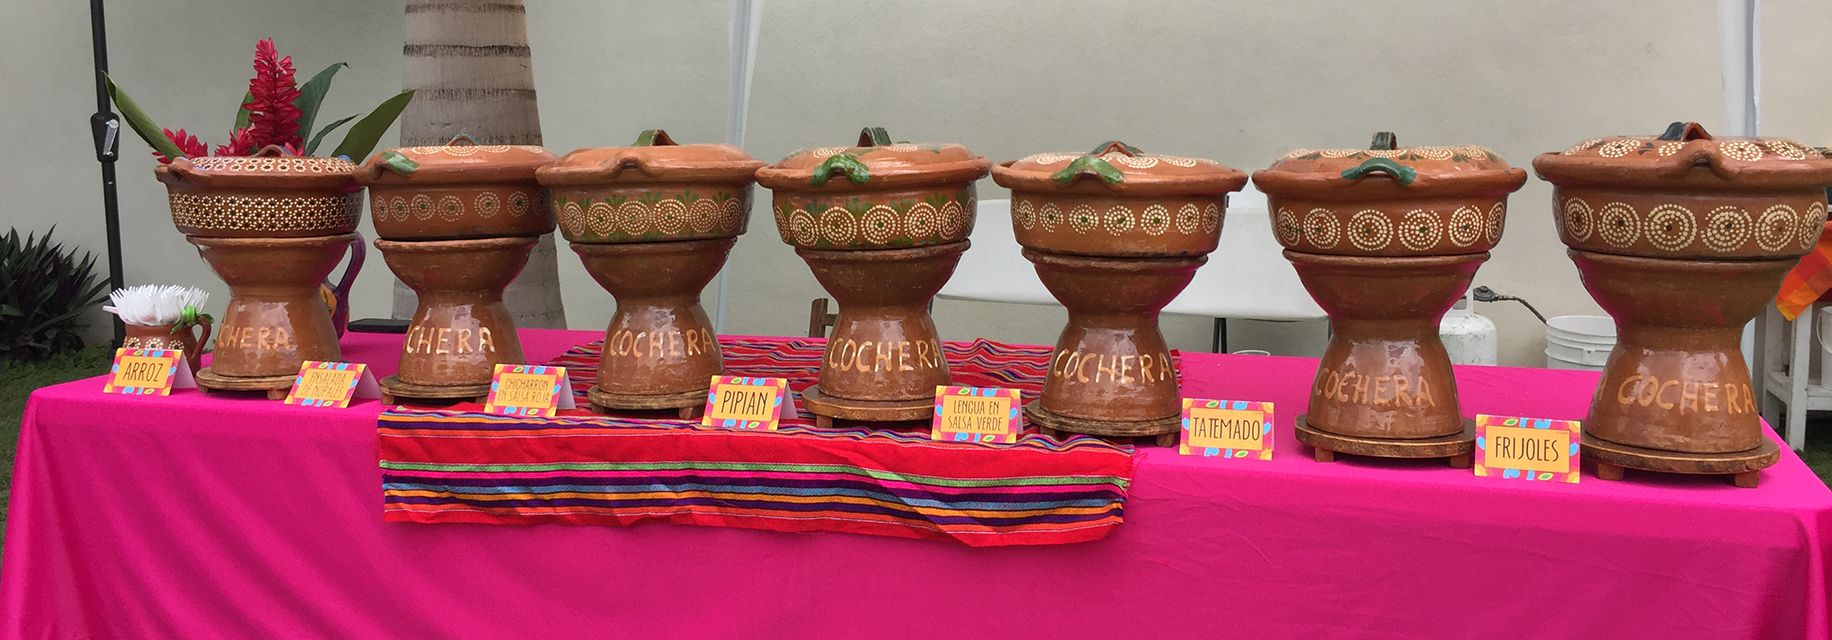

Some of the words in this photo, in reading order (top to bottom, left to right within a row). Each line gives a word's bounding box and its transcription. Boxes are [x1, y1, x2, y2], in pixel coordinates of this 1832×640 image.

[217, 324, 291, 350] CHERA
[406, 325, 496, 354] CHERA
[610, 326, 717, 358] COCHERA
[828, 337, 944, 373] COCHERA
[1053, 349, 1173, 384] COCHERA
[122, 362, 164, 383] ARROZ
[309, 371, 347, 385] ENSALADA
[504, 378, 549, 391] CHICHARRON
[498, 390, 507, 401] EN
[509, 391, 529, 402] SALSA
[530, 391, 549, 404] ROJA
[1315, 367, 1436, 408] COCHERA
[1617, 374, 1757, 416] COCHERA
[720, 390, 769, 415] PIPIAN
[953, 400, 985, 415] LENGUA
[988, 401, 1000, 416] EN
[948, 415, 972, 430] SALSA
[976, 416, 1002, 431] VERDE
[1193, 416, 1261, 441] TATEMADO
[1495, 436, 1559, 462] FRIJOLES
